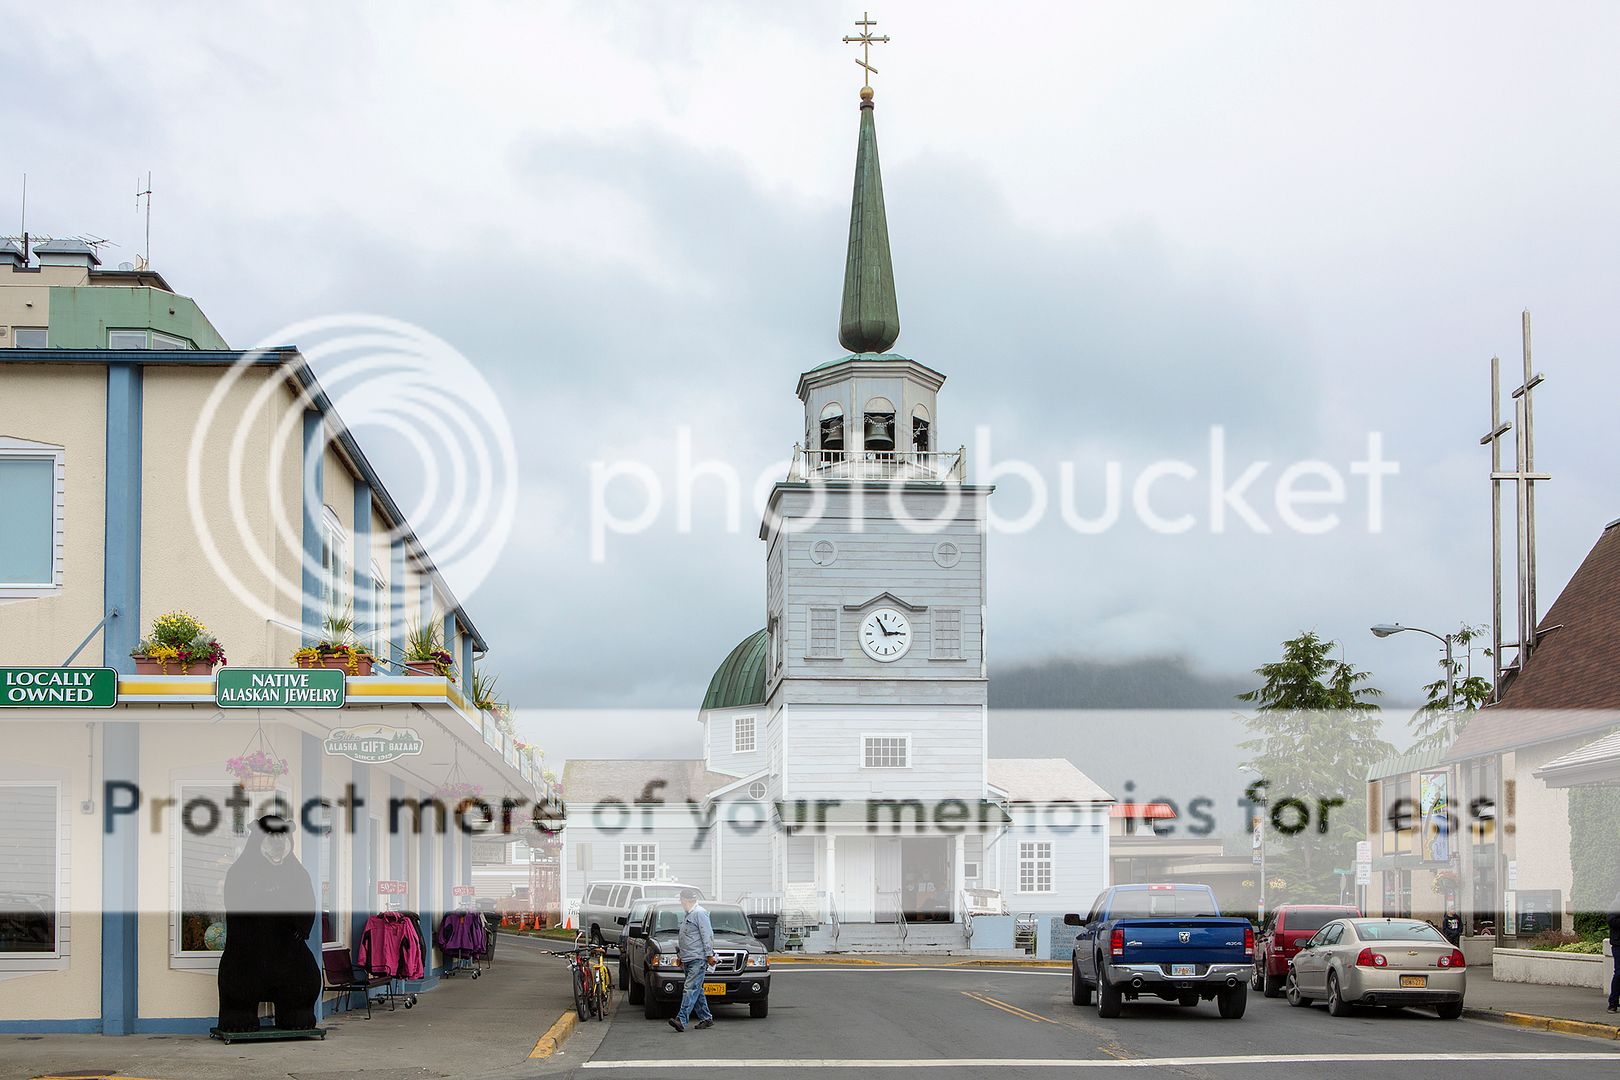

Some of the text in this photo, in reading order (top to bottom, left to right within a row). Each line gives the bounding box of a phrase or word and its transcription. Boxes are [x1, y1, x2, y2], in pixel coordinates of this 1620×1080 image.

[6, 672, 96, 687] LOCALLY
[251, 673, 310, 688] NATIVE
[8, 687, 94, 703] OWNED
[221, 687, 341, 704] ALASKAN JEWELRY
[328, 741, 419, 753] ALASKA GIFT BAZAAR
[354, 753, 376, 761] SINCE
